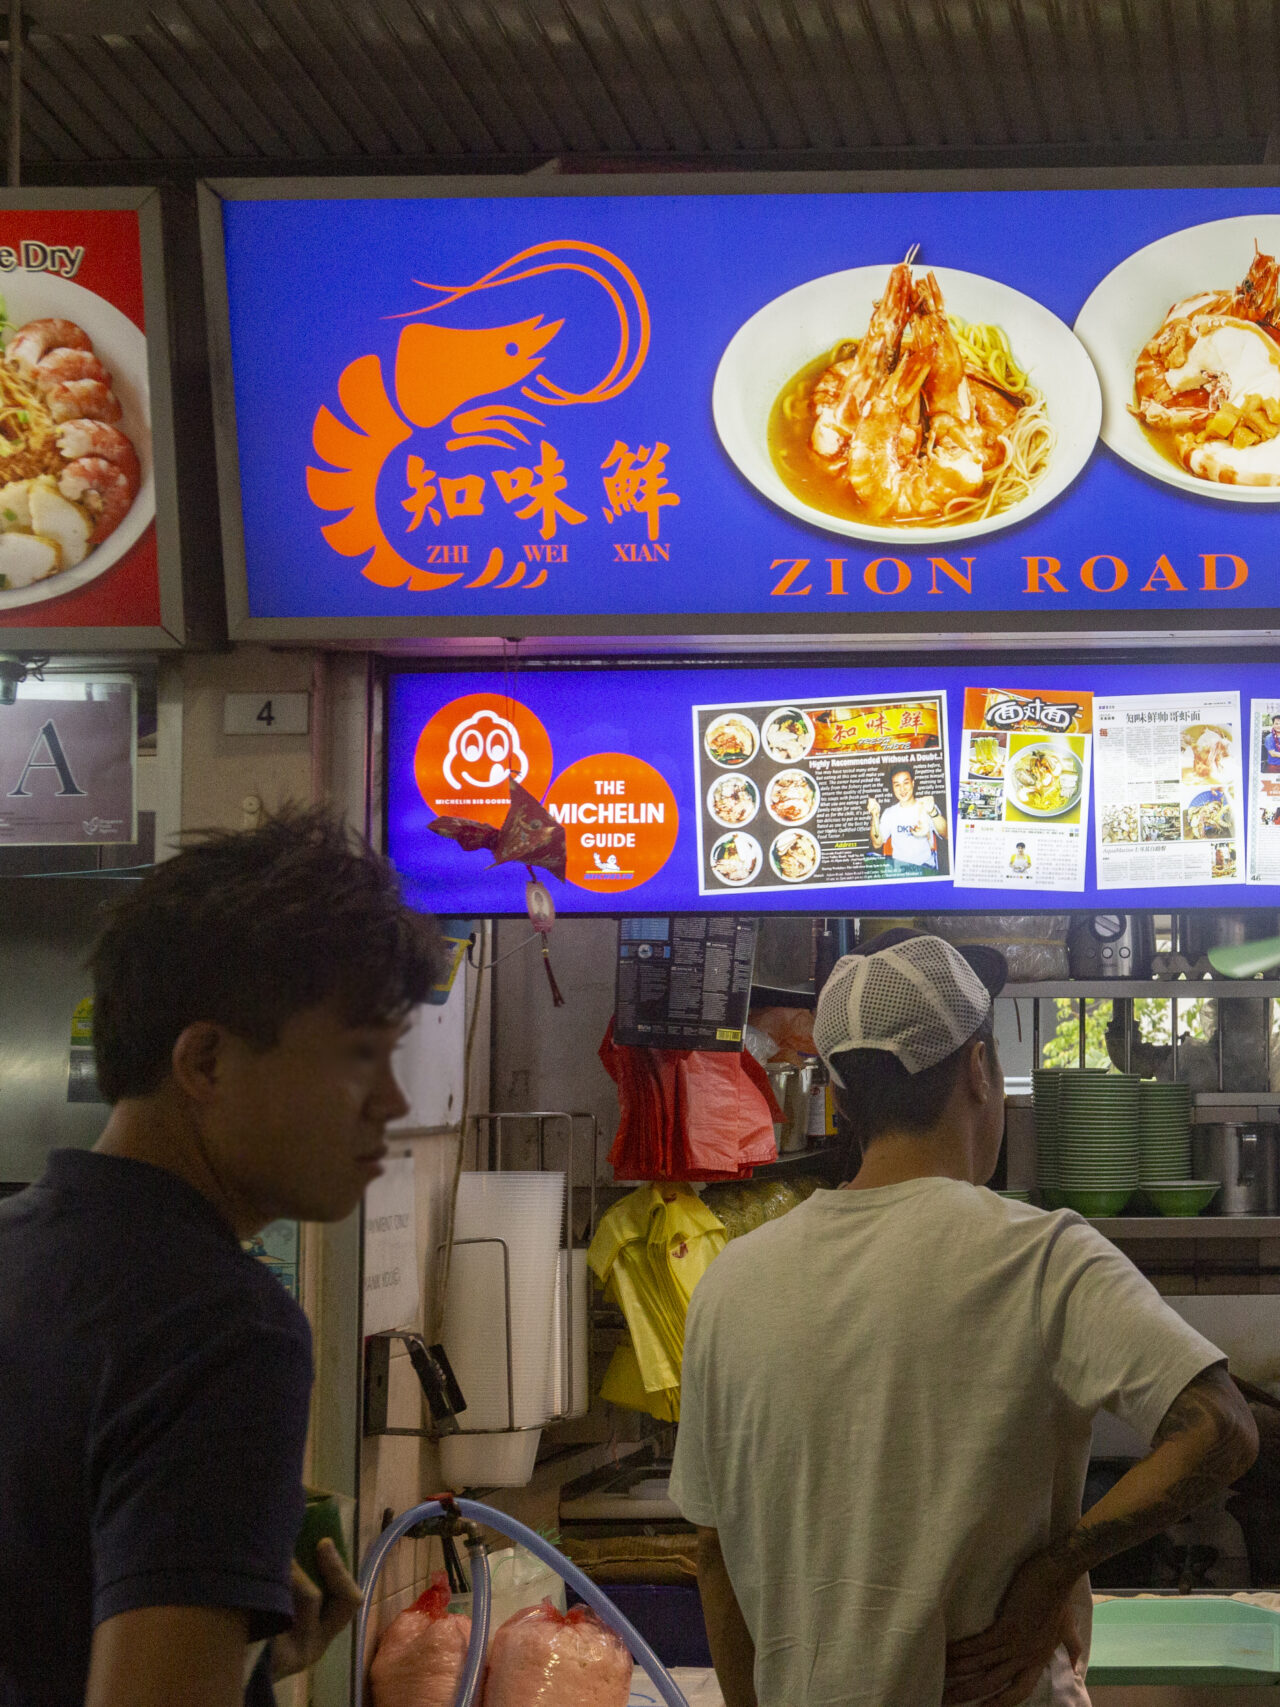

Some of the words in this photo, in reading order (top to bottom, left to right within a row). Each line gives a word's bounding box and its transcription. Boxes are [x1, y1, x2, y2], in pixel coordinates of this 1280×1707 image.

[0, 246, 17, 273] e
[20, 240, 85, 278] Dry
[401, 439, 680, 540] 知味鮮
[426, 545, 470, 564] ZHI
[523, 544, 569, 563] WEI
[613, 542, 670, 563] XIAN
[769, 556, 976, 596] ZION
[1021, 553, 1250, 593] ROAD
[257, 700, 276, 726] 4
[986, 697, 1078, 727] 面对面
[6, 718, 88, 798] A
[809, 760, 831, 770] Highly
[831, 756, 881, 767] Recommended
[881, 755, 909, 764] Without
[909, 754, 916, 762] A
[594, 780, 625, 795] THE
[548, 802, 665, 824] MICHELIN
[580, 833, 636, 848] GUIDE
[834, 841, 858, 849] Address
[365, 1214, 393, 1233] AYMENT
